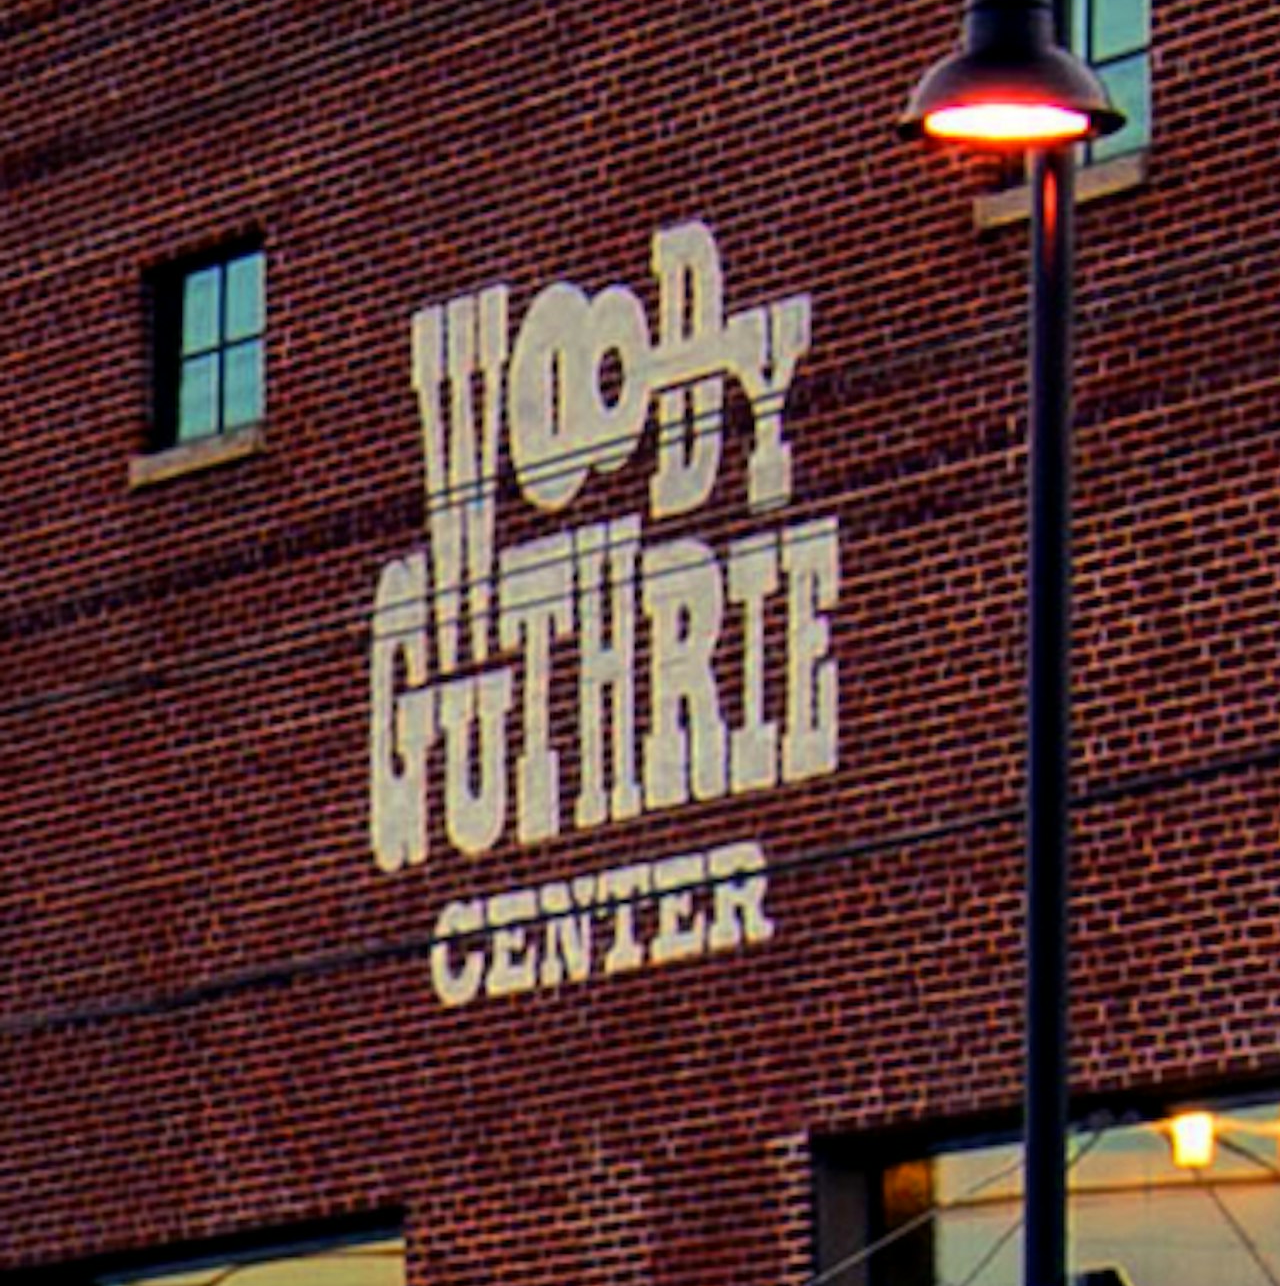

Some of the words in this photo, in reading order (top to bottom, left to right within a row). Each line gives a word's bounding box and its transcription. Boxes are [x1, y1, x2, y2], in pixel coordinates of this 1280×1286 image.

[410, 220, 812, 675] WOODY
[369, 515, 841, 871] GUTHRIE
[430, 839, 774, 1006] CENTER
